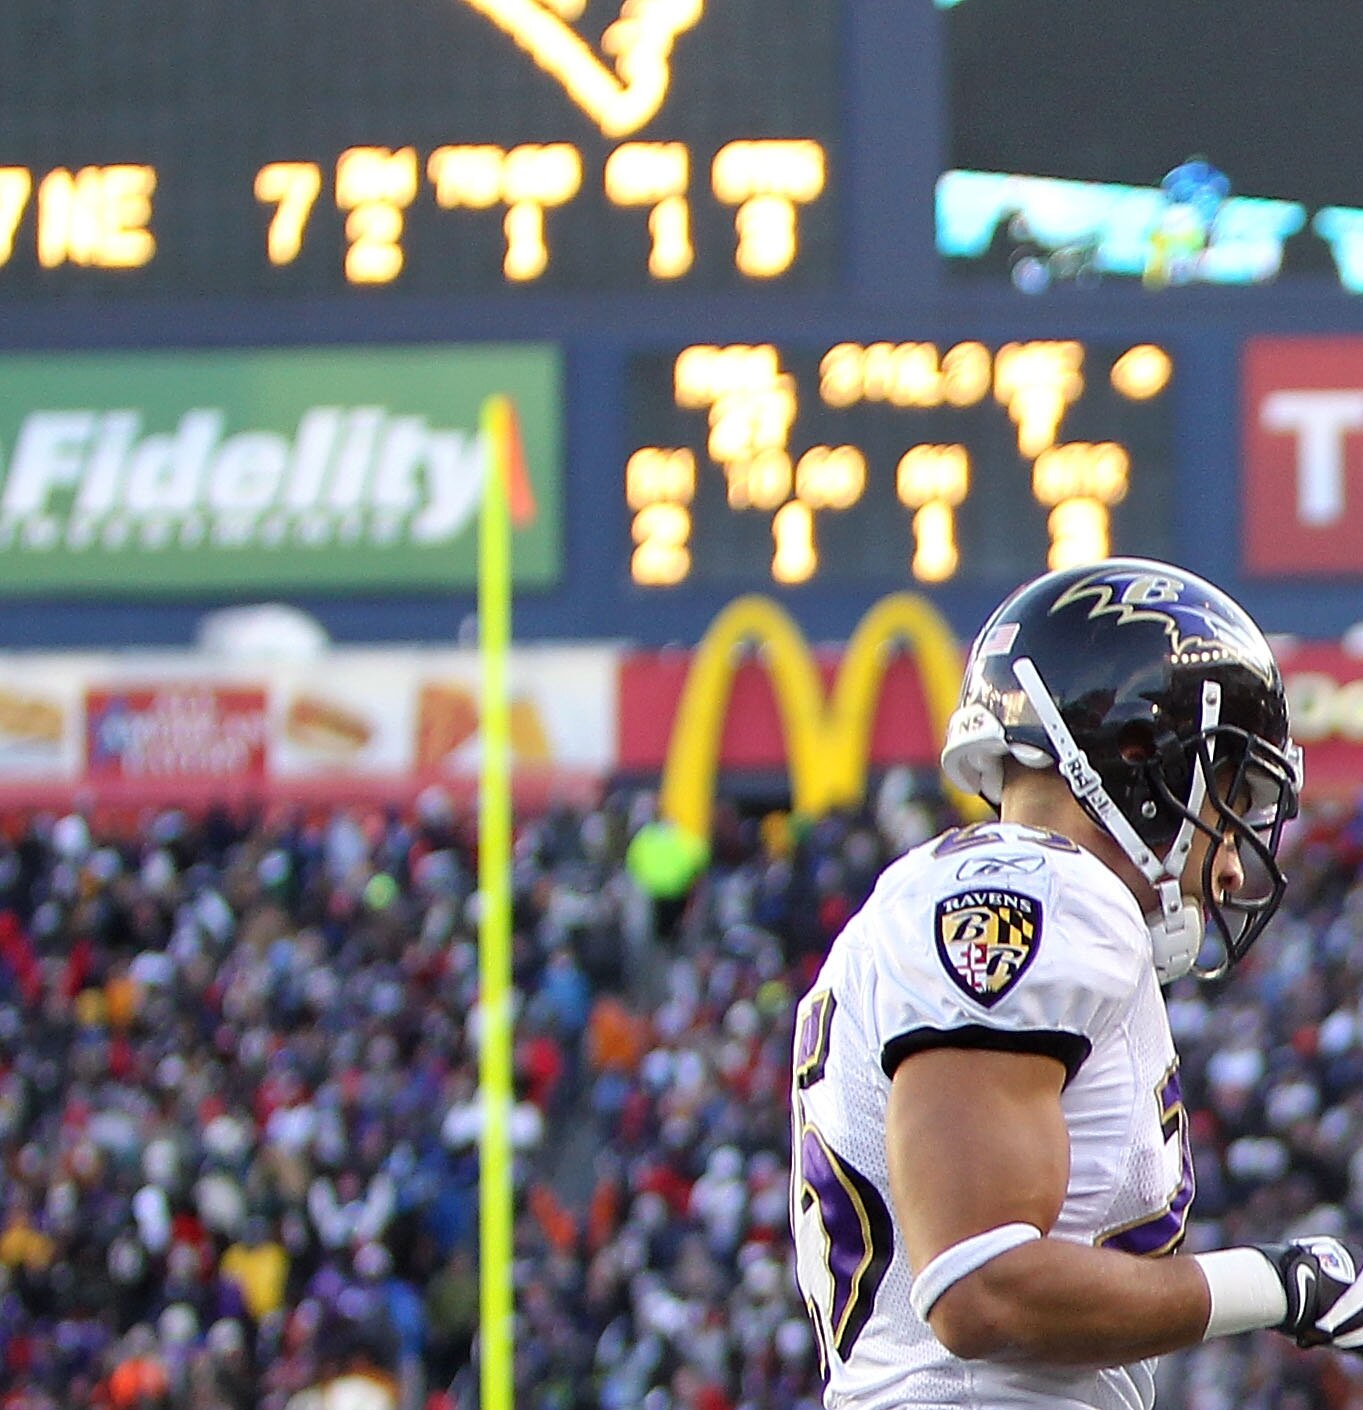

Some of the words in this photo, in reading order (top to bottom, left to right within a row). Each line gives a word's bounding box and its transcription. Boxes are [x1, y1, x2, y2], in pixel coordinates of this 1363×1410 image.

[254, 160, 322, 267] 7
[2, 406, 488, 549] Fidelity
[943, 892, 1033, 914] RAVENS
